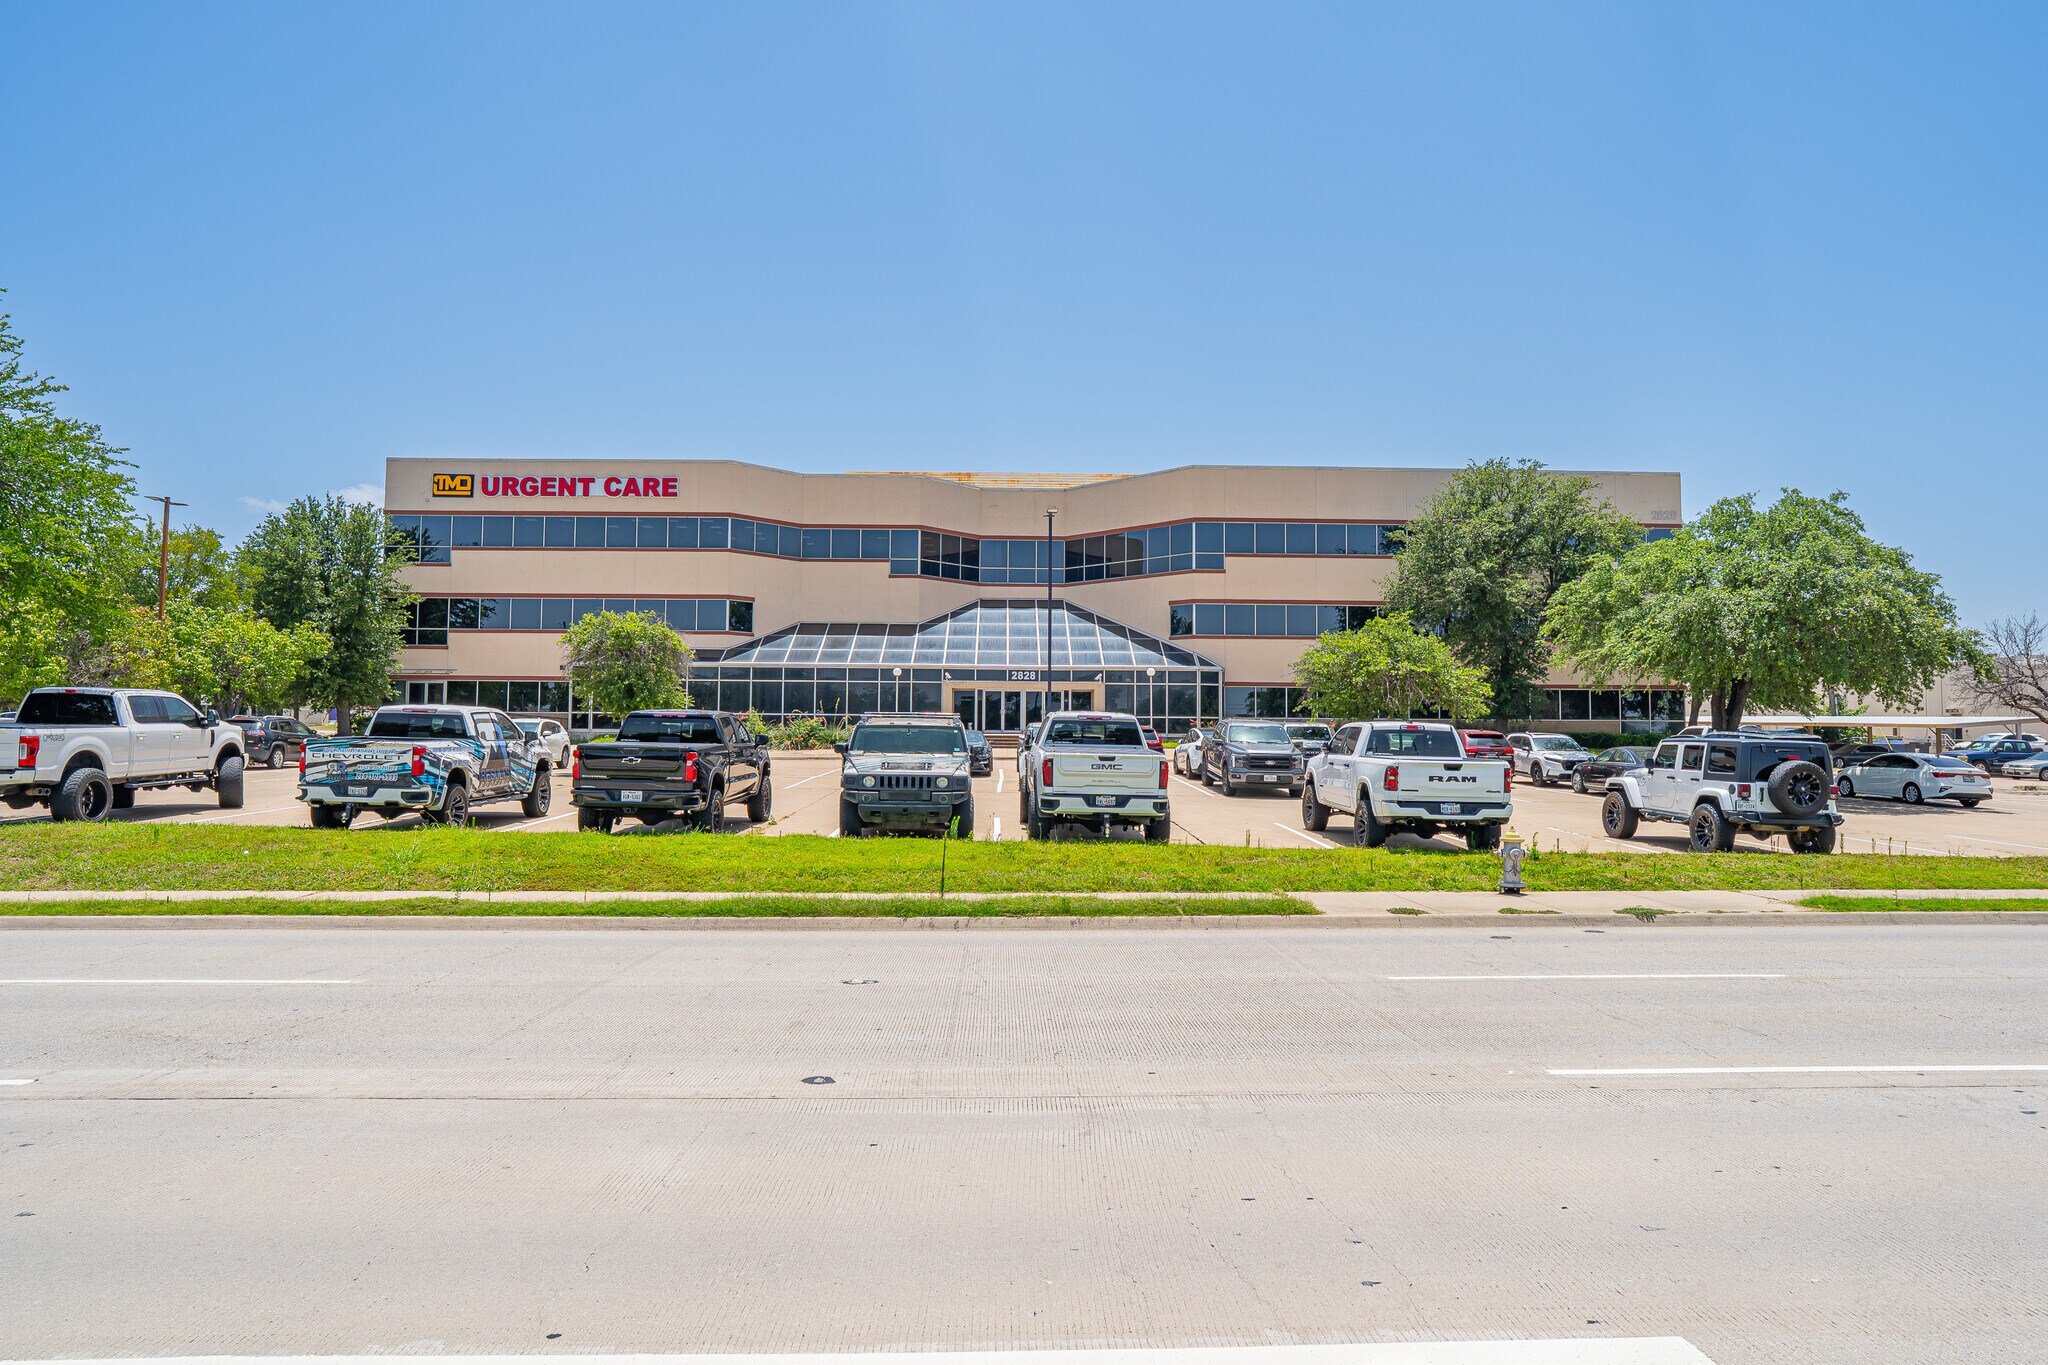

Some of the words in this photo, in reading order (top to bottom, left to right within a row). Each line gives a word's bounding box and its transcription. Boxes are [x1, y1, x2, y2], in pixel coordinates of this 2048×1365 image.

[481, 476, 597, 498] URGENT
[603, 476, 679, 498] CARE
[1011, 671, 1037, 681] 2828
[312, 753, 404, 762] CHEVROLET
[1091, 763, 1123, 771] GMC
[1428, 775, 1477, 783] RAM
